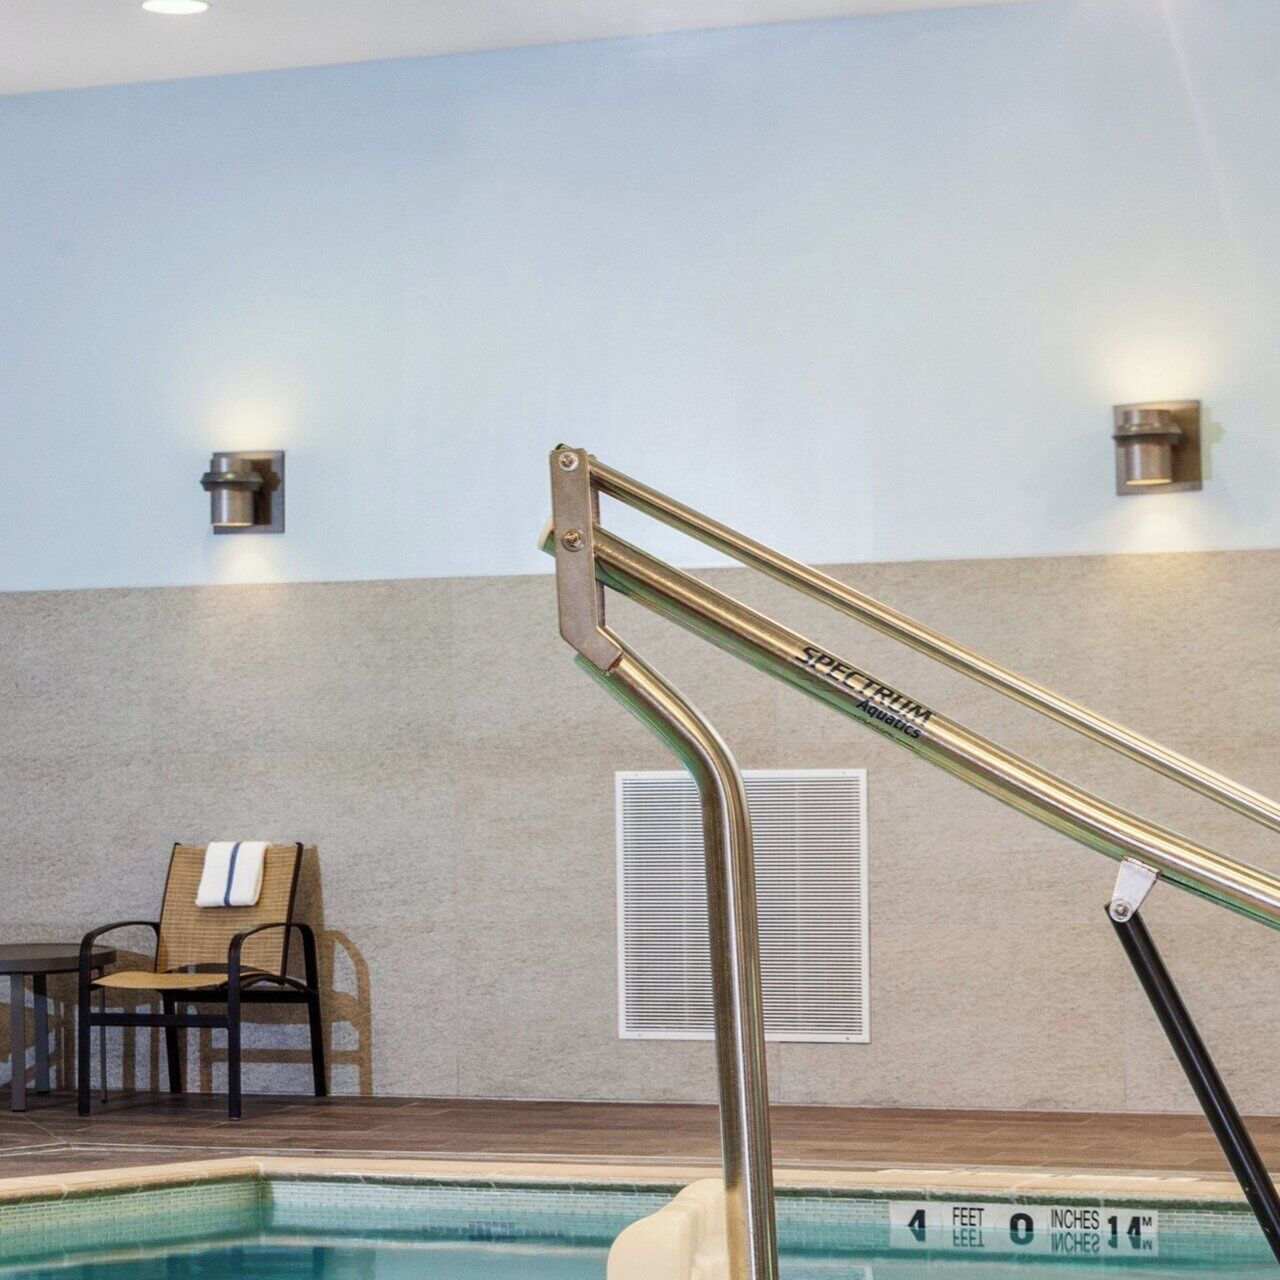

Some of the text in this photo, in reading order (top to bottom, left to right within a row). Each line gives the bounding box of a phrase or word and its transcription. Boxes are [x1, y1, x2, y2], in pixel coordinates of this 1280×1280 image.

[795, 646, 935, 727] SPECTRUM
[856, 700, 921, 739] Aquatics
[953, 1206, 985, 1226] FEET
[1051, 1209, 1100, 1230] INCHES
